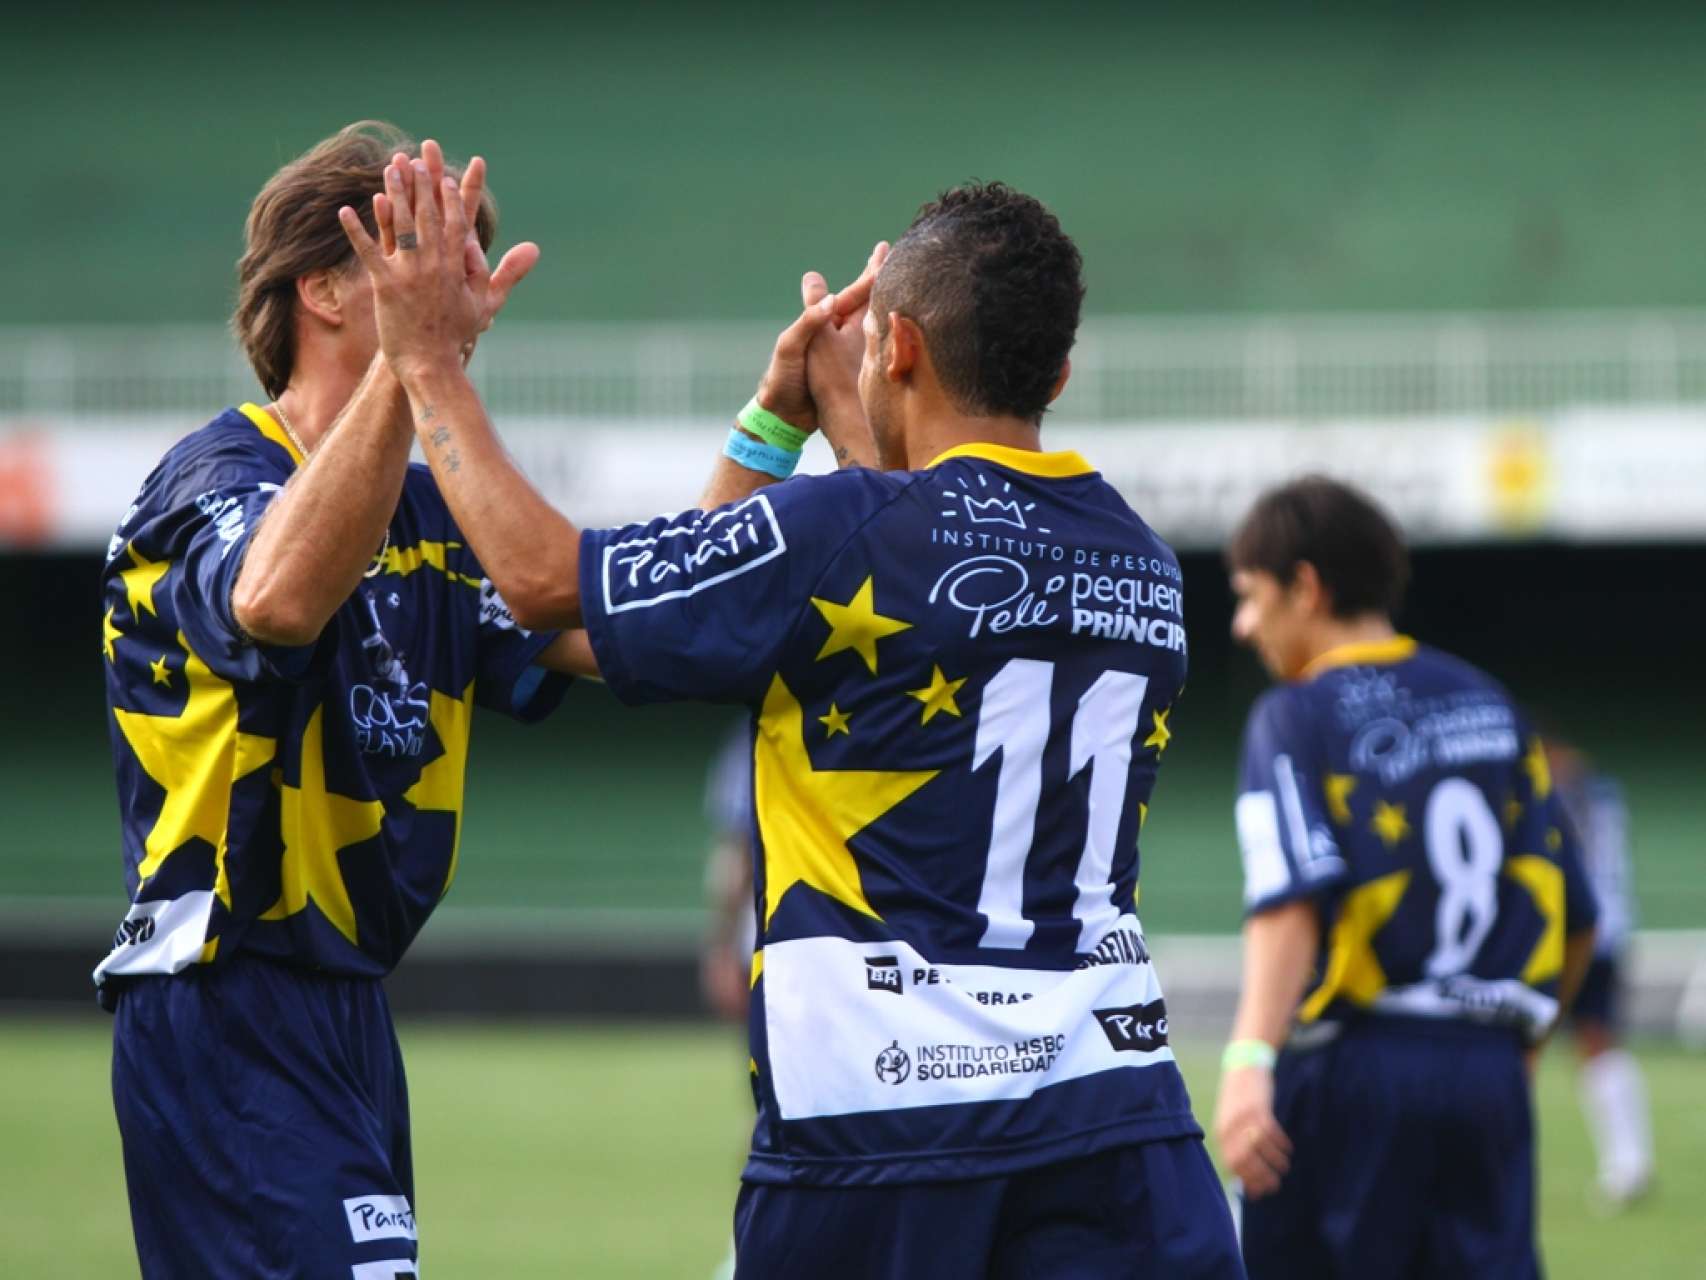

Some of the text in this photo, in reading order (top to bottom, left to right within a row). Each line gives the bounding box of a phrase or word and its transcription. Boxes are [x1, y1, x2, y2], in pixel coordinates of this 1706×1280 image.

[932, 528, 1064, 561] INSTITUTO
[1074, 549, 1100, 567] DE
[971, 657, 1149, 954] 11
[1424, 777, 1504, 977] 8
[917, 1034, 1065, 1062] INSTITUTO HSBC
